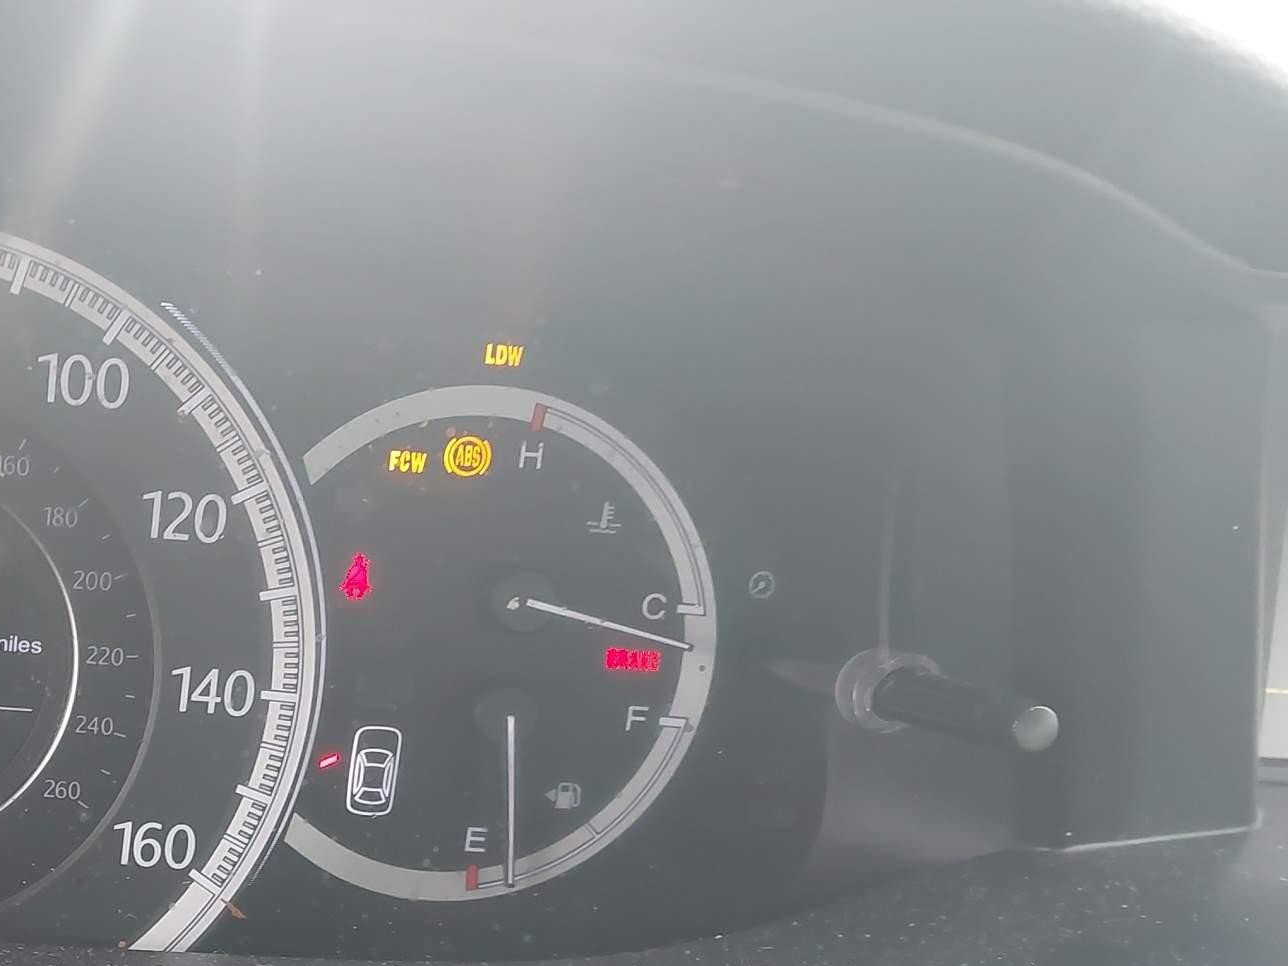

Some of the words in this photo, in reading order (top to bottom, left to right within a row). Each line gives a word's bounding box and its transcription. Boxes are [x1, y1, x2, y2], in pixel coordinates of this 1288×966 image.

[484, 343, 524, 367] LDW
[37, 353, 130, 409] 100
[388, 450, 427, 474] FCW
[455, 444, 482, 468] ABS
[518, 441, 544, 470] H
[43, 506, 78, 529] 180
[142, 490, 228, 544] 120
[72, 570, 112, 592] 200
[641, 593, 667, 621] C
[86, 646, 125, 667] 220
[170, 665, 256, 718] 140
[75, 715, 114, 736] 240
[626, 705, 650, 731] F
[43, 778, 81, 800] 260
[113, 820, 197, 870] 160
[464, 826, 489, 853] E
